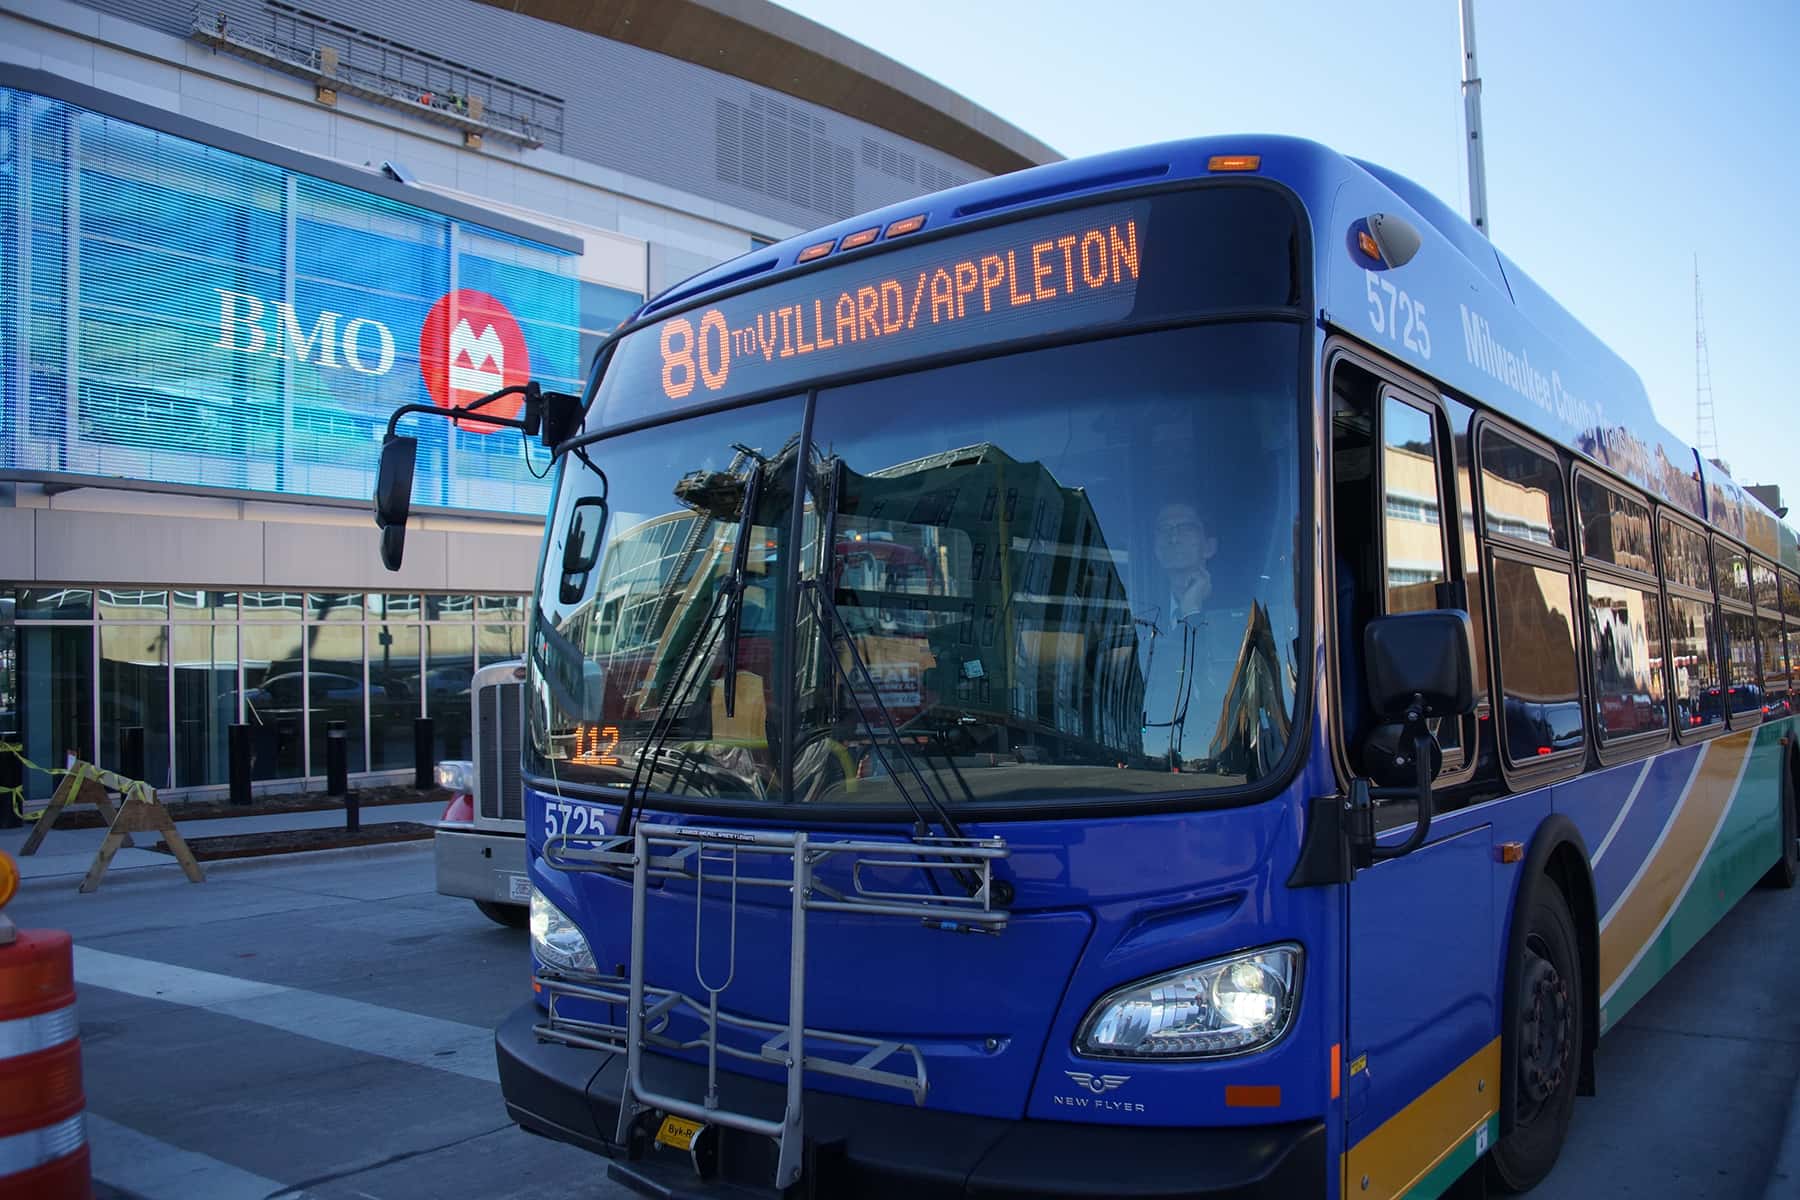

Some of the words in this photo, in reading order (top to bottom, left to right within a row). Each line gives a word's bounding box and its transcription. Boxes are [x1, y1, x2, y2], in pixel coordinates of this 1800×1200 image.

[213, 288, 395, 376] BMO
[660, 309, 730, 399] 80
[732, 327, 756, 357] TO
[756, 219, 1139, 361] VILLARD/APPLETON
[1365, 268, 1431, 360] 5725
[1460, 303, 1553, 413] Milwaukee
[571, 726, 619, 765] 112
[545, 802, 606, 847] 5725
[1053, 1095, 1089, 1107] NEW
[1095, 1099, 1145, 1112] FLYER
